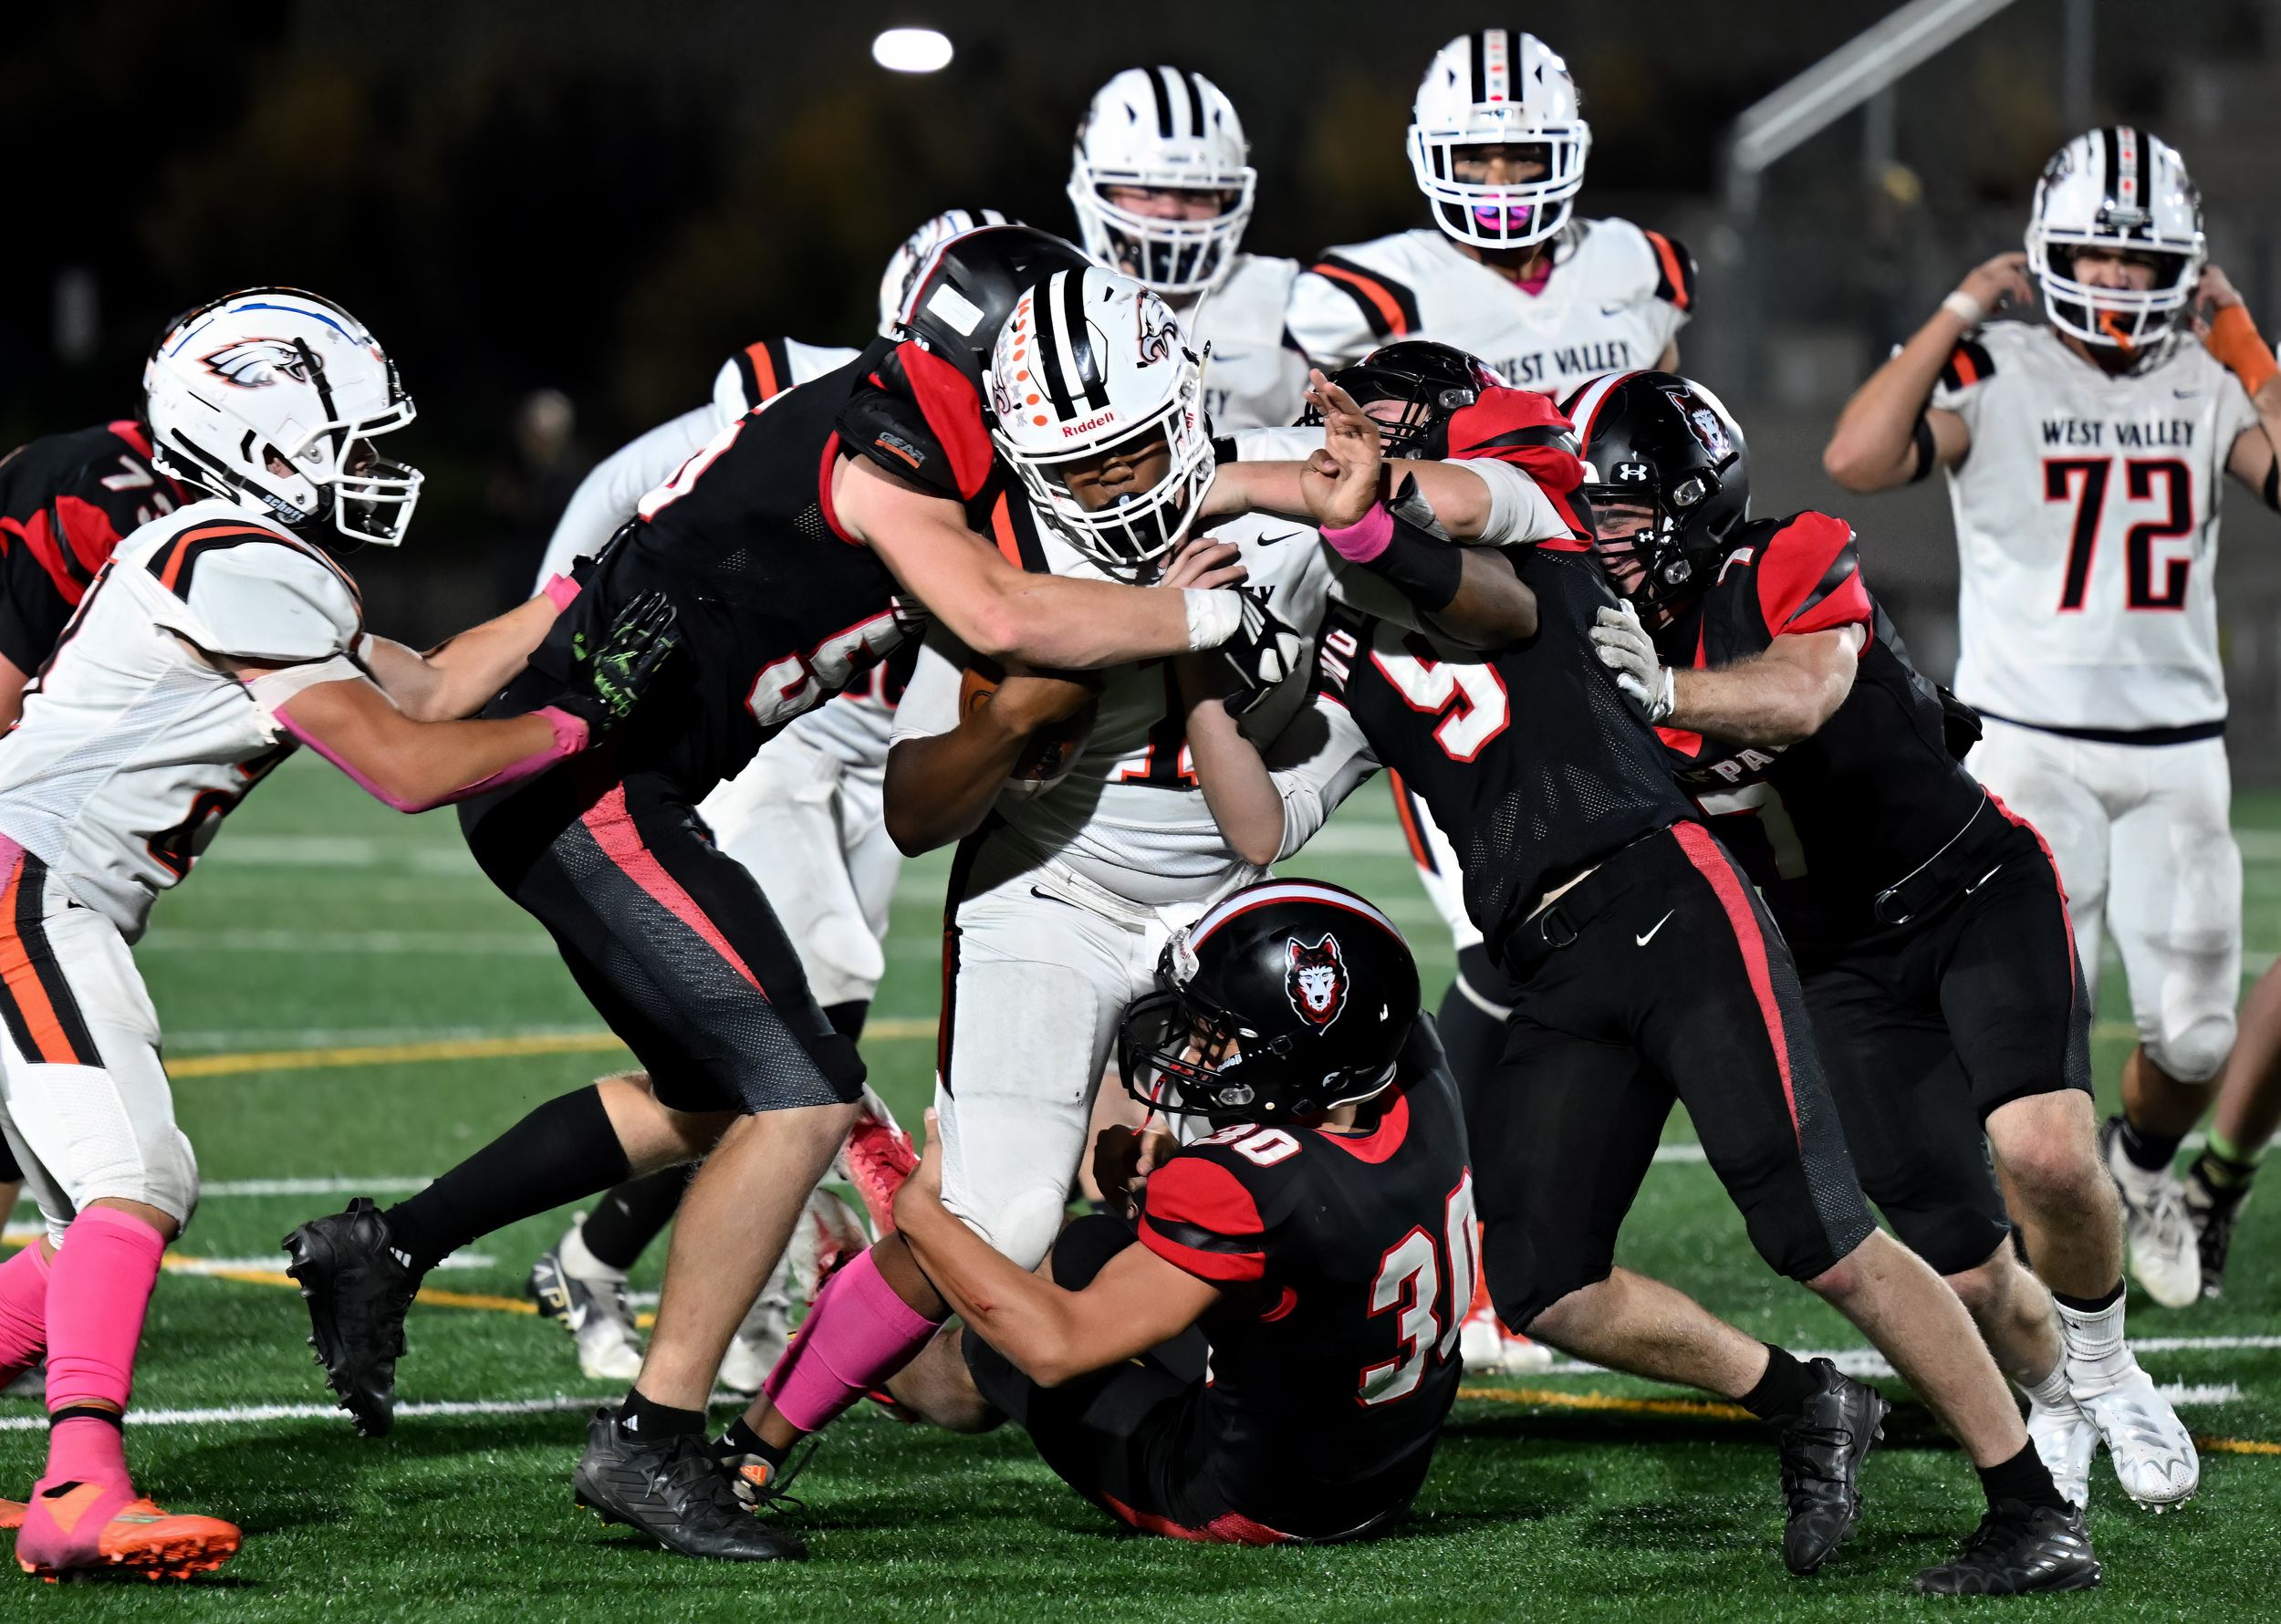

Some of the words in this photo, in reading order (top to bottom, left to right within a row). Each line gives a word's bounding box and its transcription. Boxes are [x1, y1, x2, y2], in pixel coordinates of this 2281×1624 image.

[1554, 341, 1631, 376] VALLEY
[1061, 411, 1115, 438] Riddell
[2042, 419, 2102, 446] WEST
[2115, 420, 2194, 448] VALLEY
[2042, 456, 2194, 612] 72
[1693, 778, 1809, 881] 7
[1187, 1122, 1304, 1169] 30
[1354, 1164, 1480, 1410] 30
